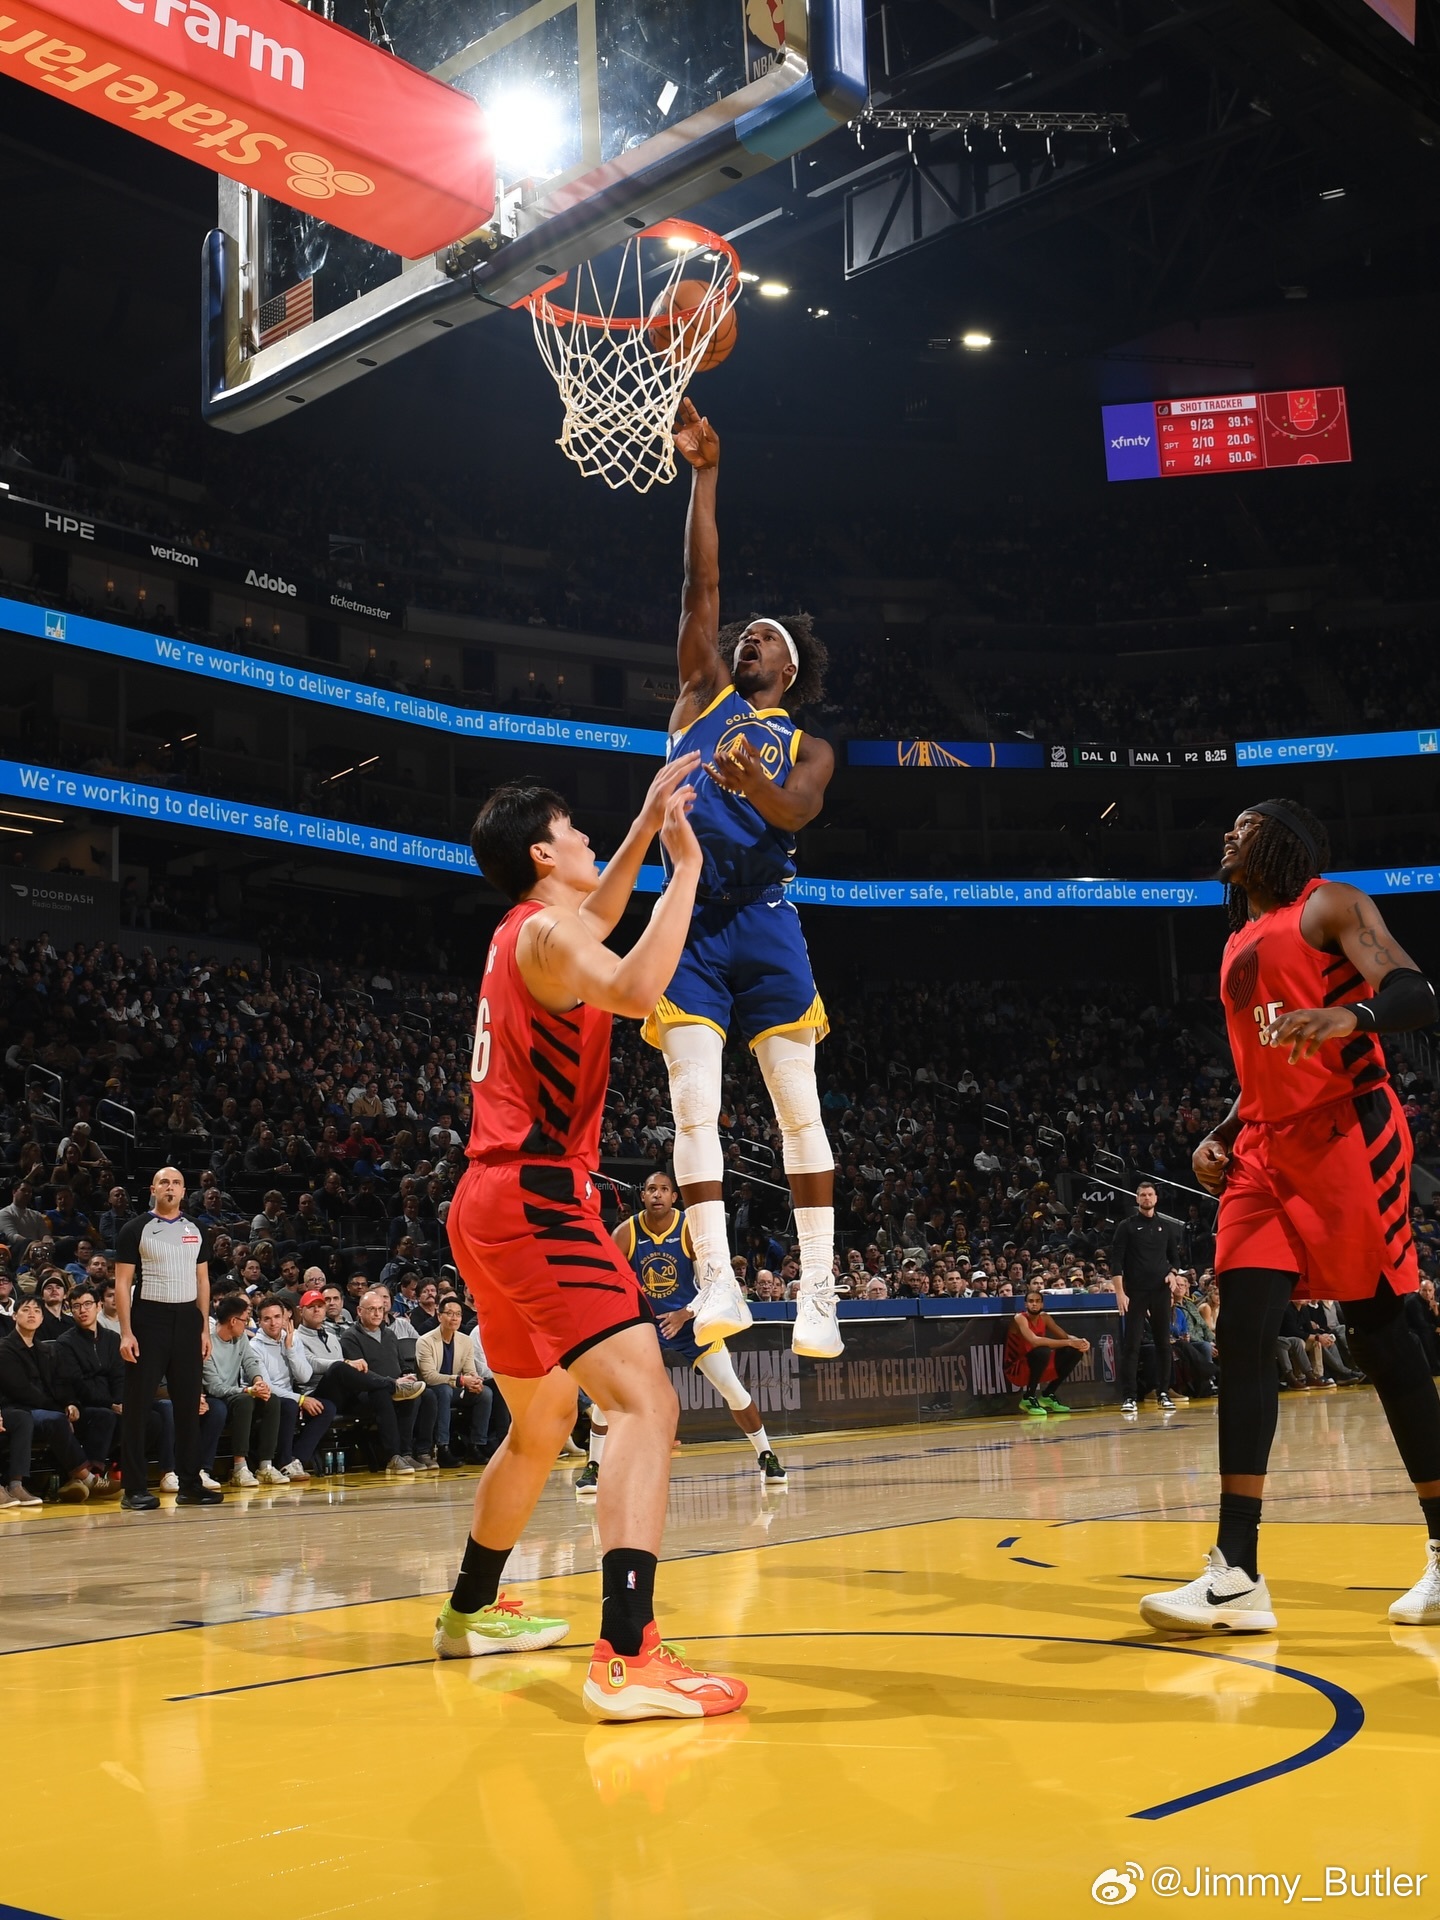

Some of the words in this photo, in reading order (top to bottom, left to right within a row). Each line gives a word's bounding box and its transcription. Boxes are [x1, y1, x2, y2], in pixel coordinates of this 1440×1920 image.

[1180, 401, 1201, 412] SHOT
[1205, 399, 1243, 410] TRACKER
[1190, 418, 1214, 431] 9/23
[1228, 416, 1253, 428] 39.1%
[1111, 434, 1151, 449] xfinity
[1192, 436, 1214, 449] 2/10
[1227, 433, 1255, 446] 20.0%
[1194, 453, 1211, 466] 2/4
[1229, 451, 1257, 463] 50.0%
[45, 512, 95, 541] HPE
[150, 545, 199, 568] verizon
[245, 569, 298, 597] Adobe
[329, 594, 392, 620] ticketmaster
[156, 639, 203, 665] We're
[209, 657, 274, 686] working
[280, 671, 293, 687] to
[299, 676, 351, 699] deliver
[356, 692, 389, 711] safe,
[395, 701, 451, 725] reliable,
[456, 715, 483, 729] and
[489, 717, 569, 738] affordable
[576, 729, 630, 747] energy.
[760, 742, 778, 763] 10
[1081, 751, 1103, 761] DAL
[1110, 751, 1117, 762] 0
[1136, 752, 1159, 762] ANA
[1166, 752, 1171, 763] 1
[1185, 752, 1198, 762] P2
[1205, 750, 1227, 762] 8:25
[20, 768, 76, 795] We're
[83, 785, 158, 814] working
[166, 796, 181, 813] to
[189, 800, 248, 824] deliver
[254, 815, 292, 836] safe,
[300, 822, 364, 848] reliable,
[370, 837, 397, 852] and
[403, 840, 476, 866] affordable
[1385, 872, 1433, 886] We're
[32, 888, 94, 904] DOORDASH
[831, 885, 844, 898] to
[850, 885, 904, 899] deliver
[910, 885, 947, 900] safe,
[954, 885, 1018, 900] reliable,
[1024, 885, 1051, 898] and
[1058, 885, 1136, 899] affordable
[1142, 885, 1198, 902] energy.
[32, 900, 51, 909] Radio
[52, 902, 72, 911] Booth
[640, 1252, 660, 1265] GOLDEN
[662, 1252, 678, 1264] STATE
[661, 1265, 674, 1276] 20
[641, 1283, 680, 1299] WARRIORS
[970, 1344, 1007, 1395] MLK
[814, 1362, 845, 1401] THE
[848, 1360, 879, 1399] NBA
[881, 1355, 967, 1397] CELEBRATES
